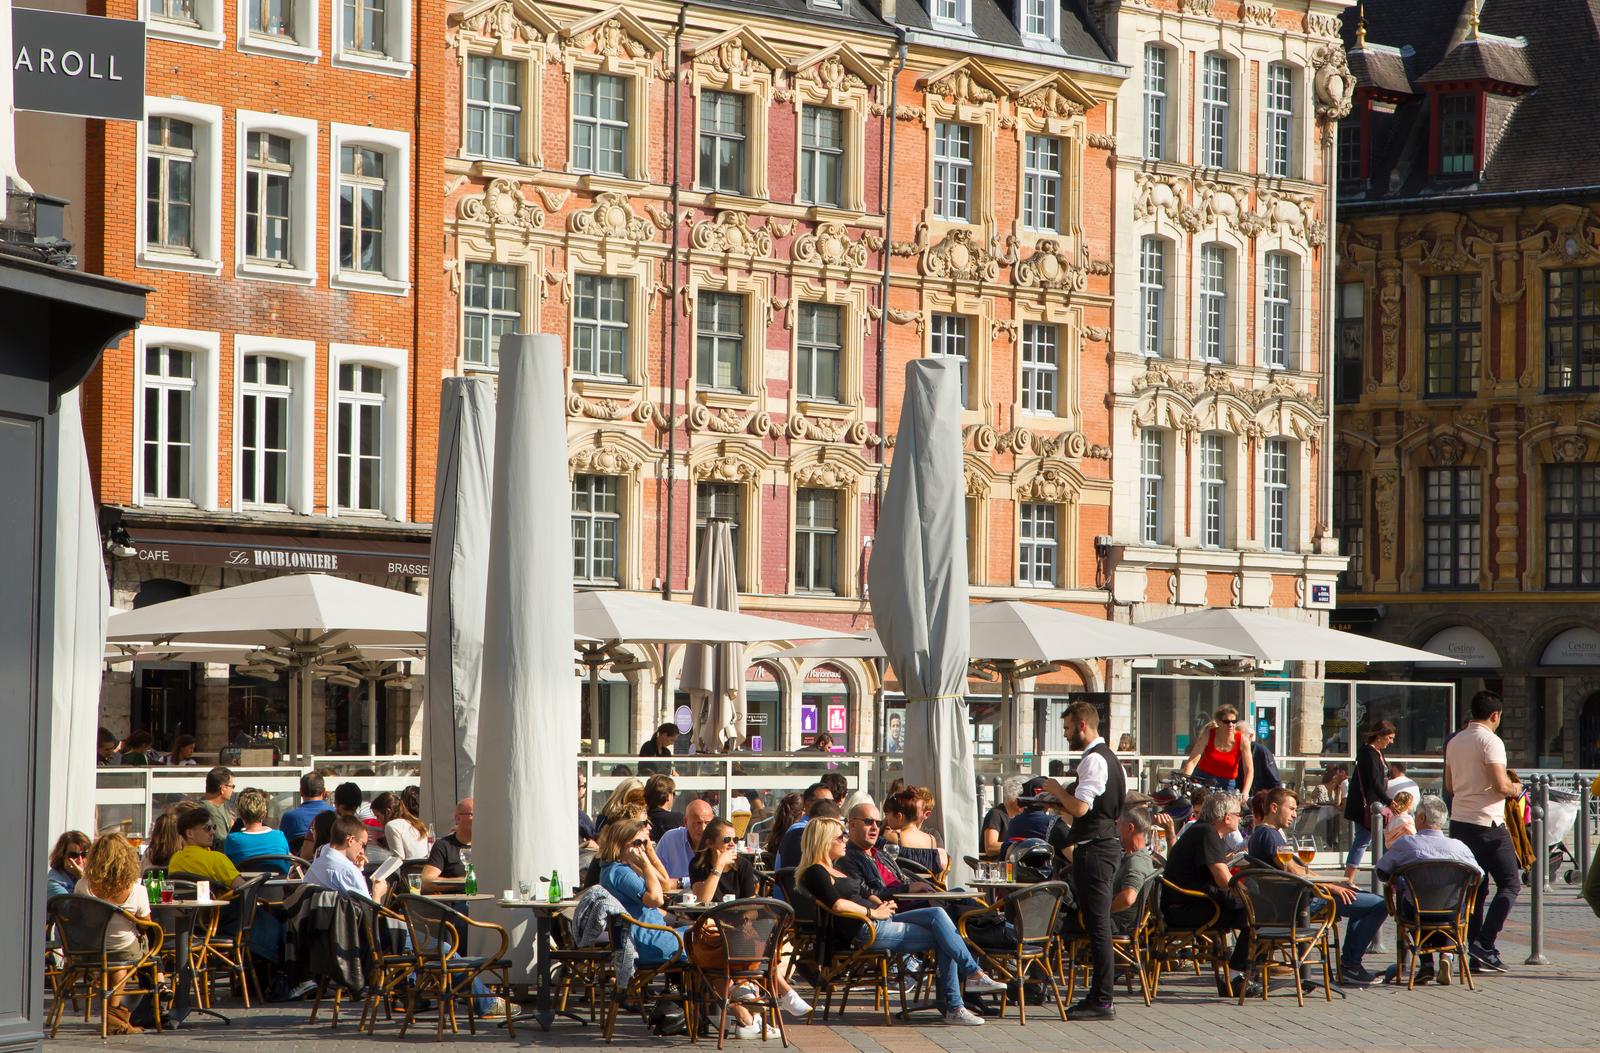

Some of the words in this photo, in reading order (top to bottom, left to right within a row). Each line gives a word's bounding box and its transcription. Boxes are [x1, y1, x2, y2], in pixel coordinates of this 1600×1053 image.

[14, 45, 123, 81] AROLL
[138, 549, 170, 562] CAFE
[224, 550, 250, 565] La
[254, 549, 338, 570] HOUBLONNIERE
